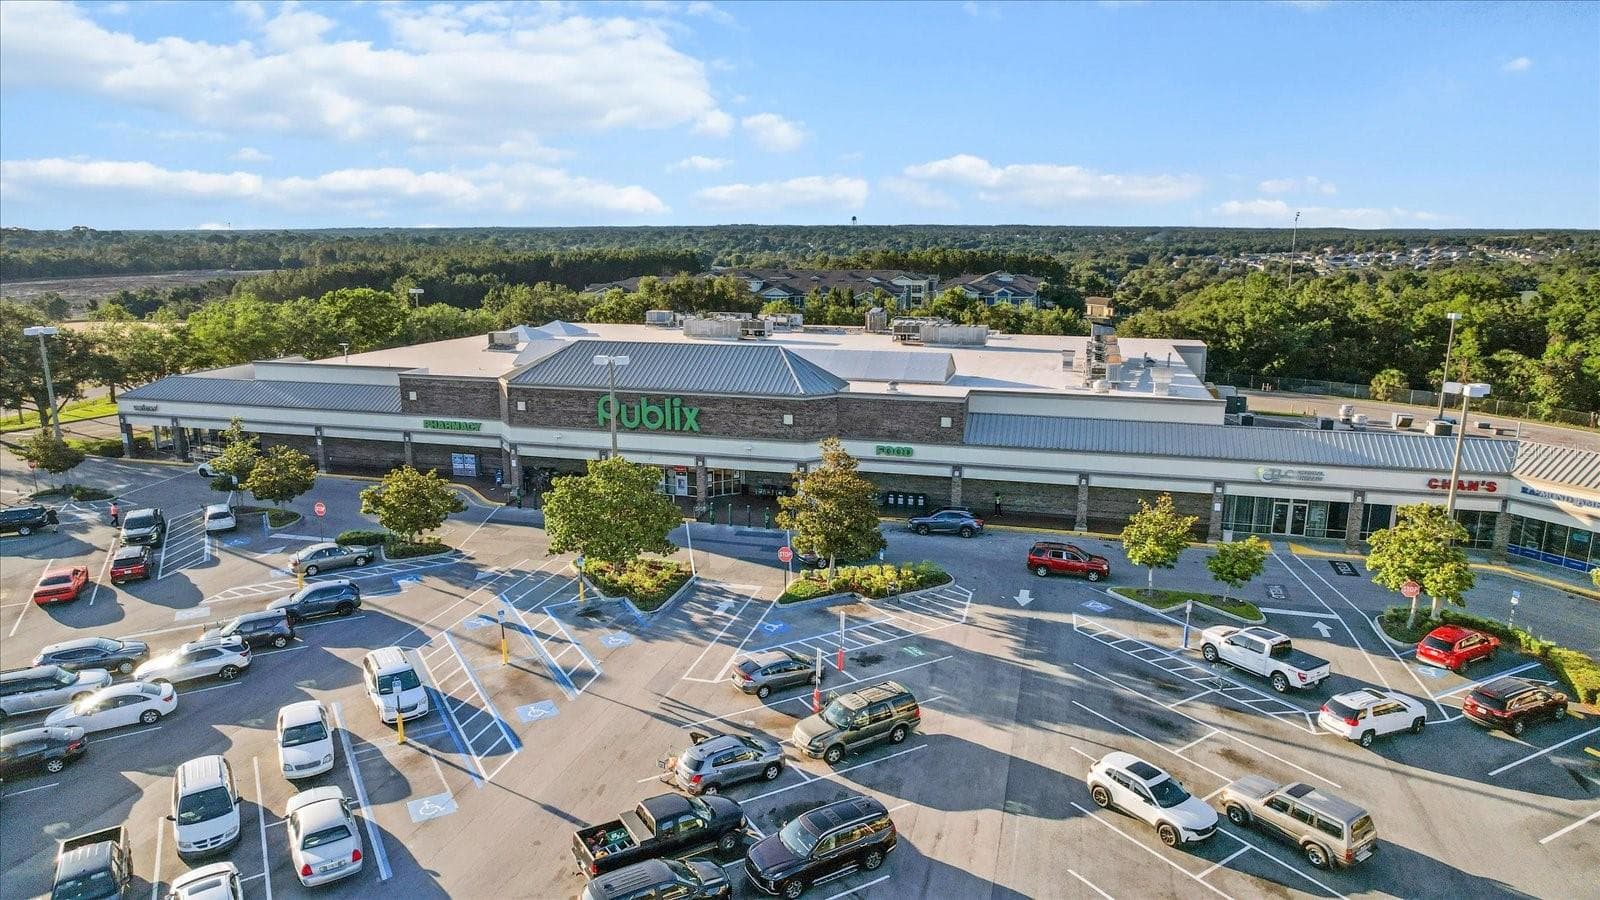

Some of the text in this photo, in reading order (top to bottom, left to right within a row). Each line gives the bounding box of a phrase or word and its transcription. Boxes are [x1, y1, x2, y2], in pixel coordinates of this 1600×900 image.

[598, 394, 700, 432] Publix
[423, 419, 482, 432] PHARMACY
[876, 445, 914, 457] FOOD
[1427, 478, 1497, 492] CHAN'S
